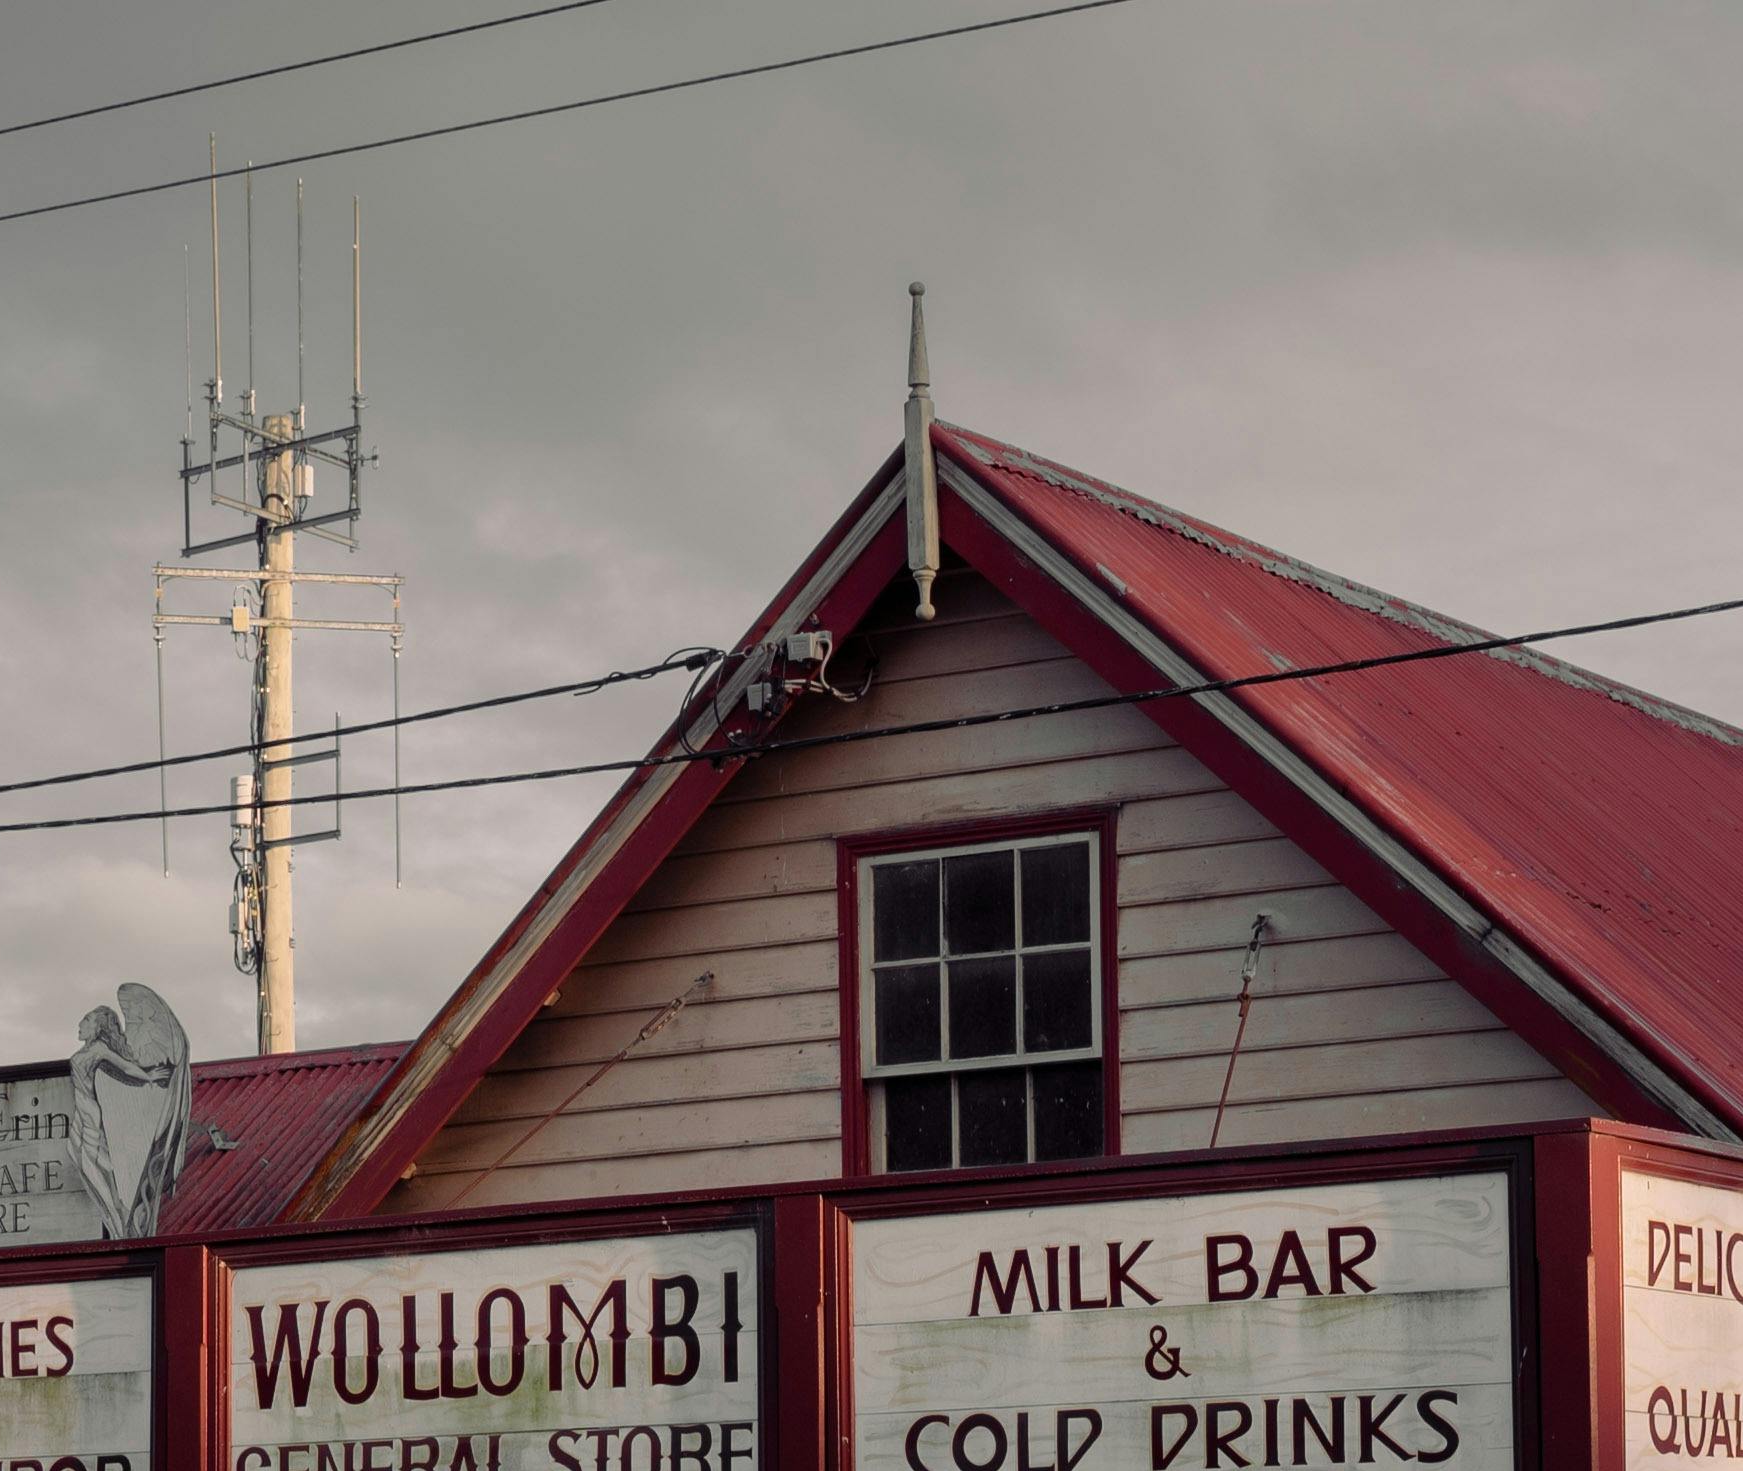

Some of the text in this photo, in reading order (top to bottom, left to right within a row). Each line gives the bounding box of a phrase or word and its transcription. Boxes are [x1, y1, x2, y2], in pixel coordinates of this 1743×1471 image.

[968, 1225, 1377, 1317] MILK BAR
[244, 1270, 743, 1410] WOLLOMBI
[1144, 1324, 1191, 1381] &
[1150, 1390, 1459, 1471] DRINKS
